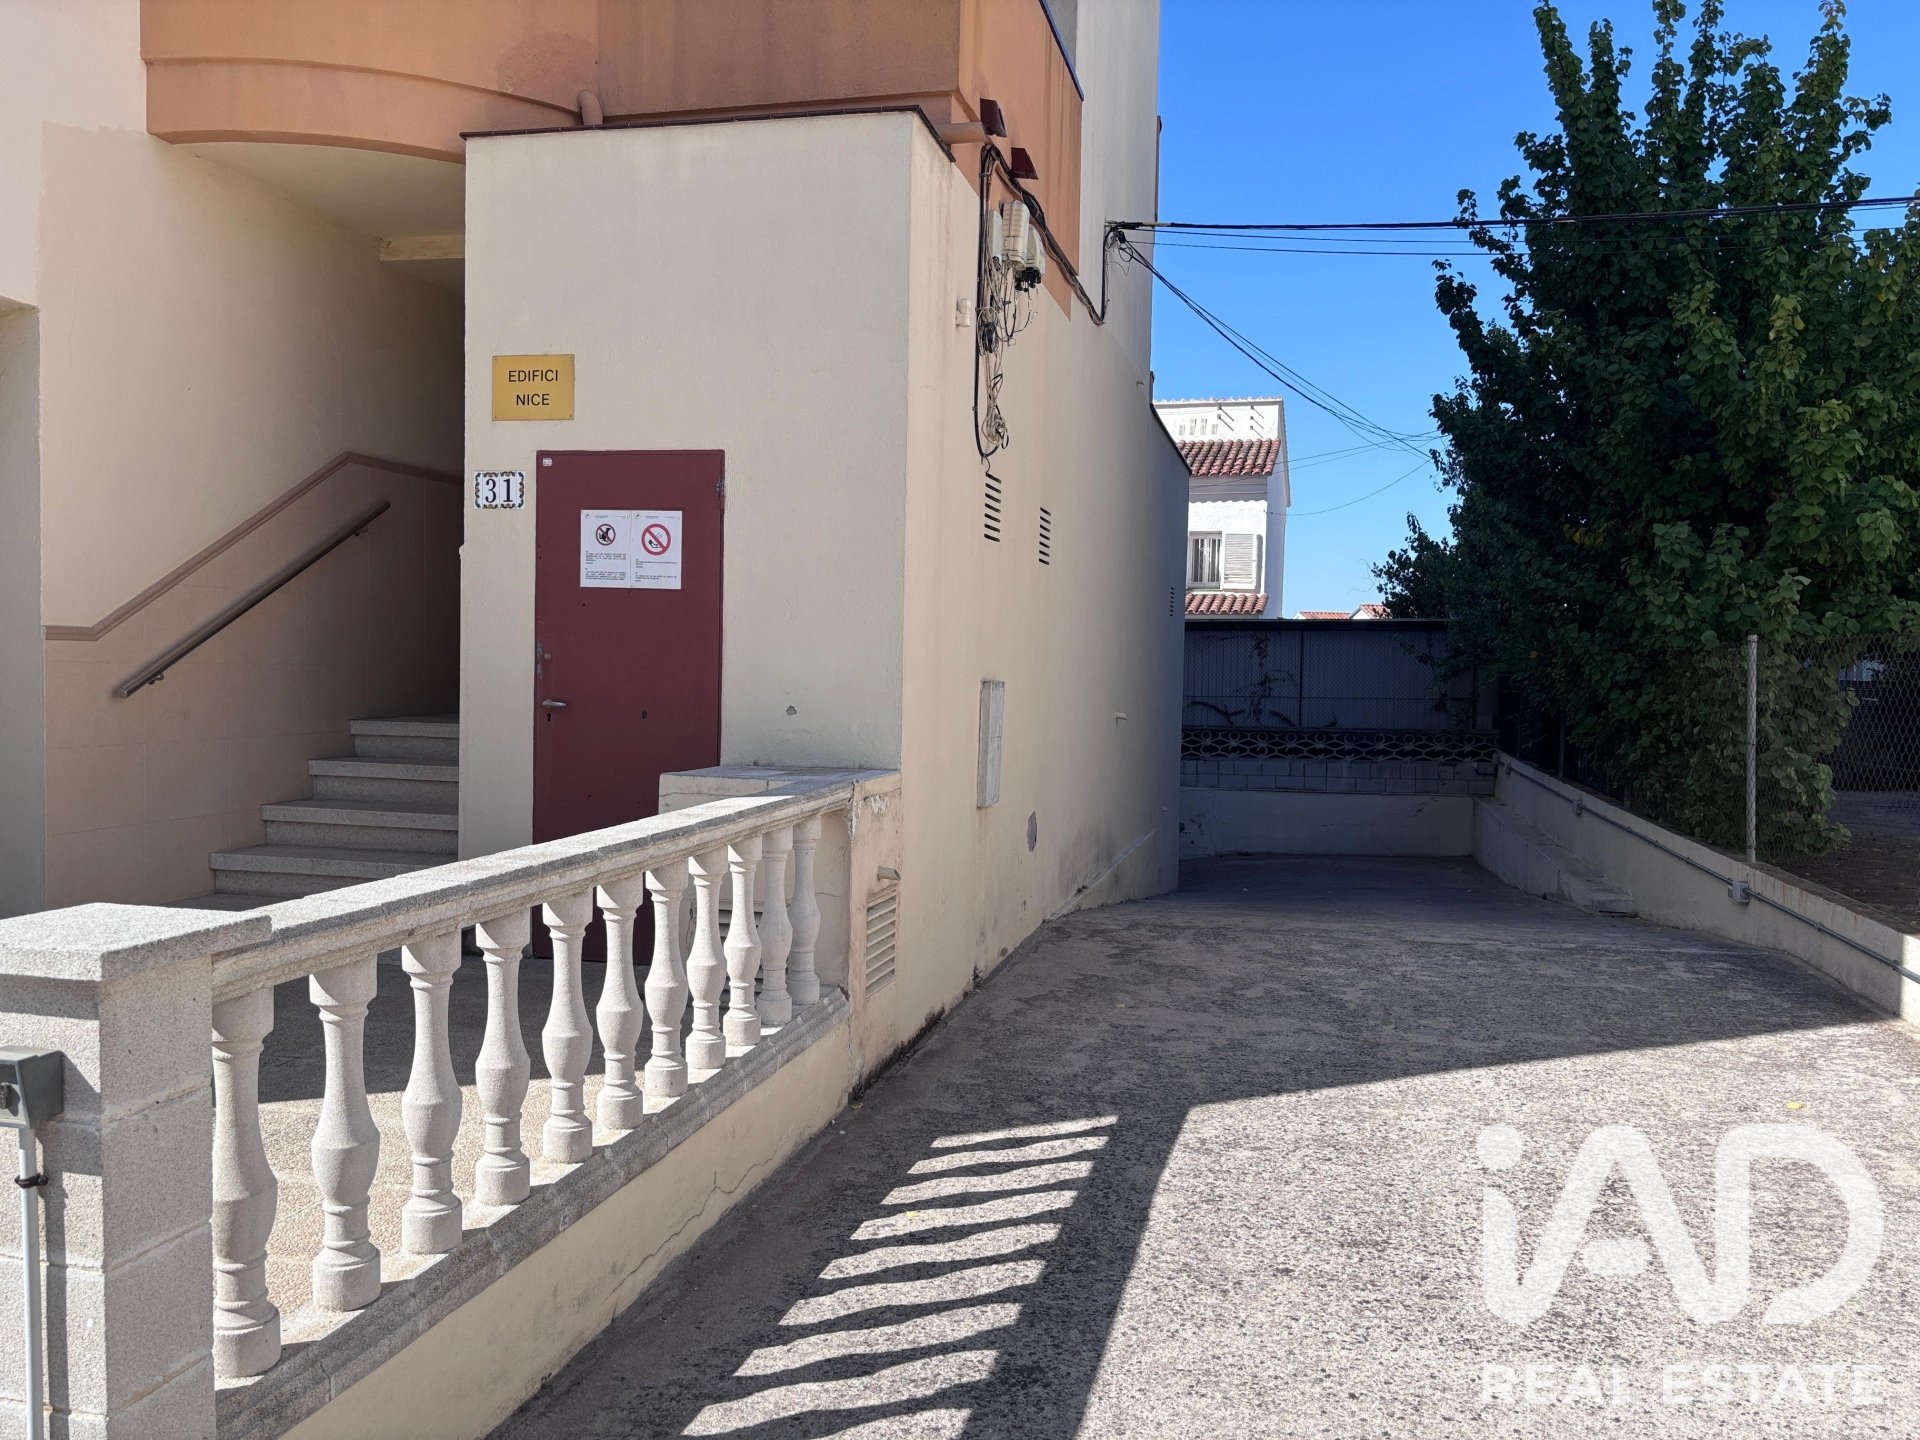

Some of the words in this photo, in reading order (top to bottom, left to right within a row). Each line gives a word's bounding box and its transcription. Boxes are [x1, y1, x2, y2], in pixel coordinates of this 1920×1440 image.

[508, 369, 559, 383] EDIFICI
[516, 393, 550, 406] NICE
[485, 478, 514, 503] 31
